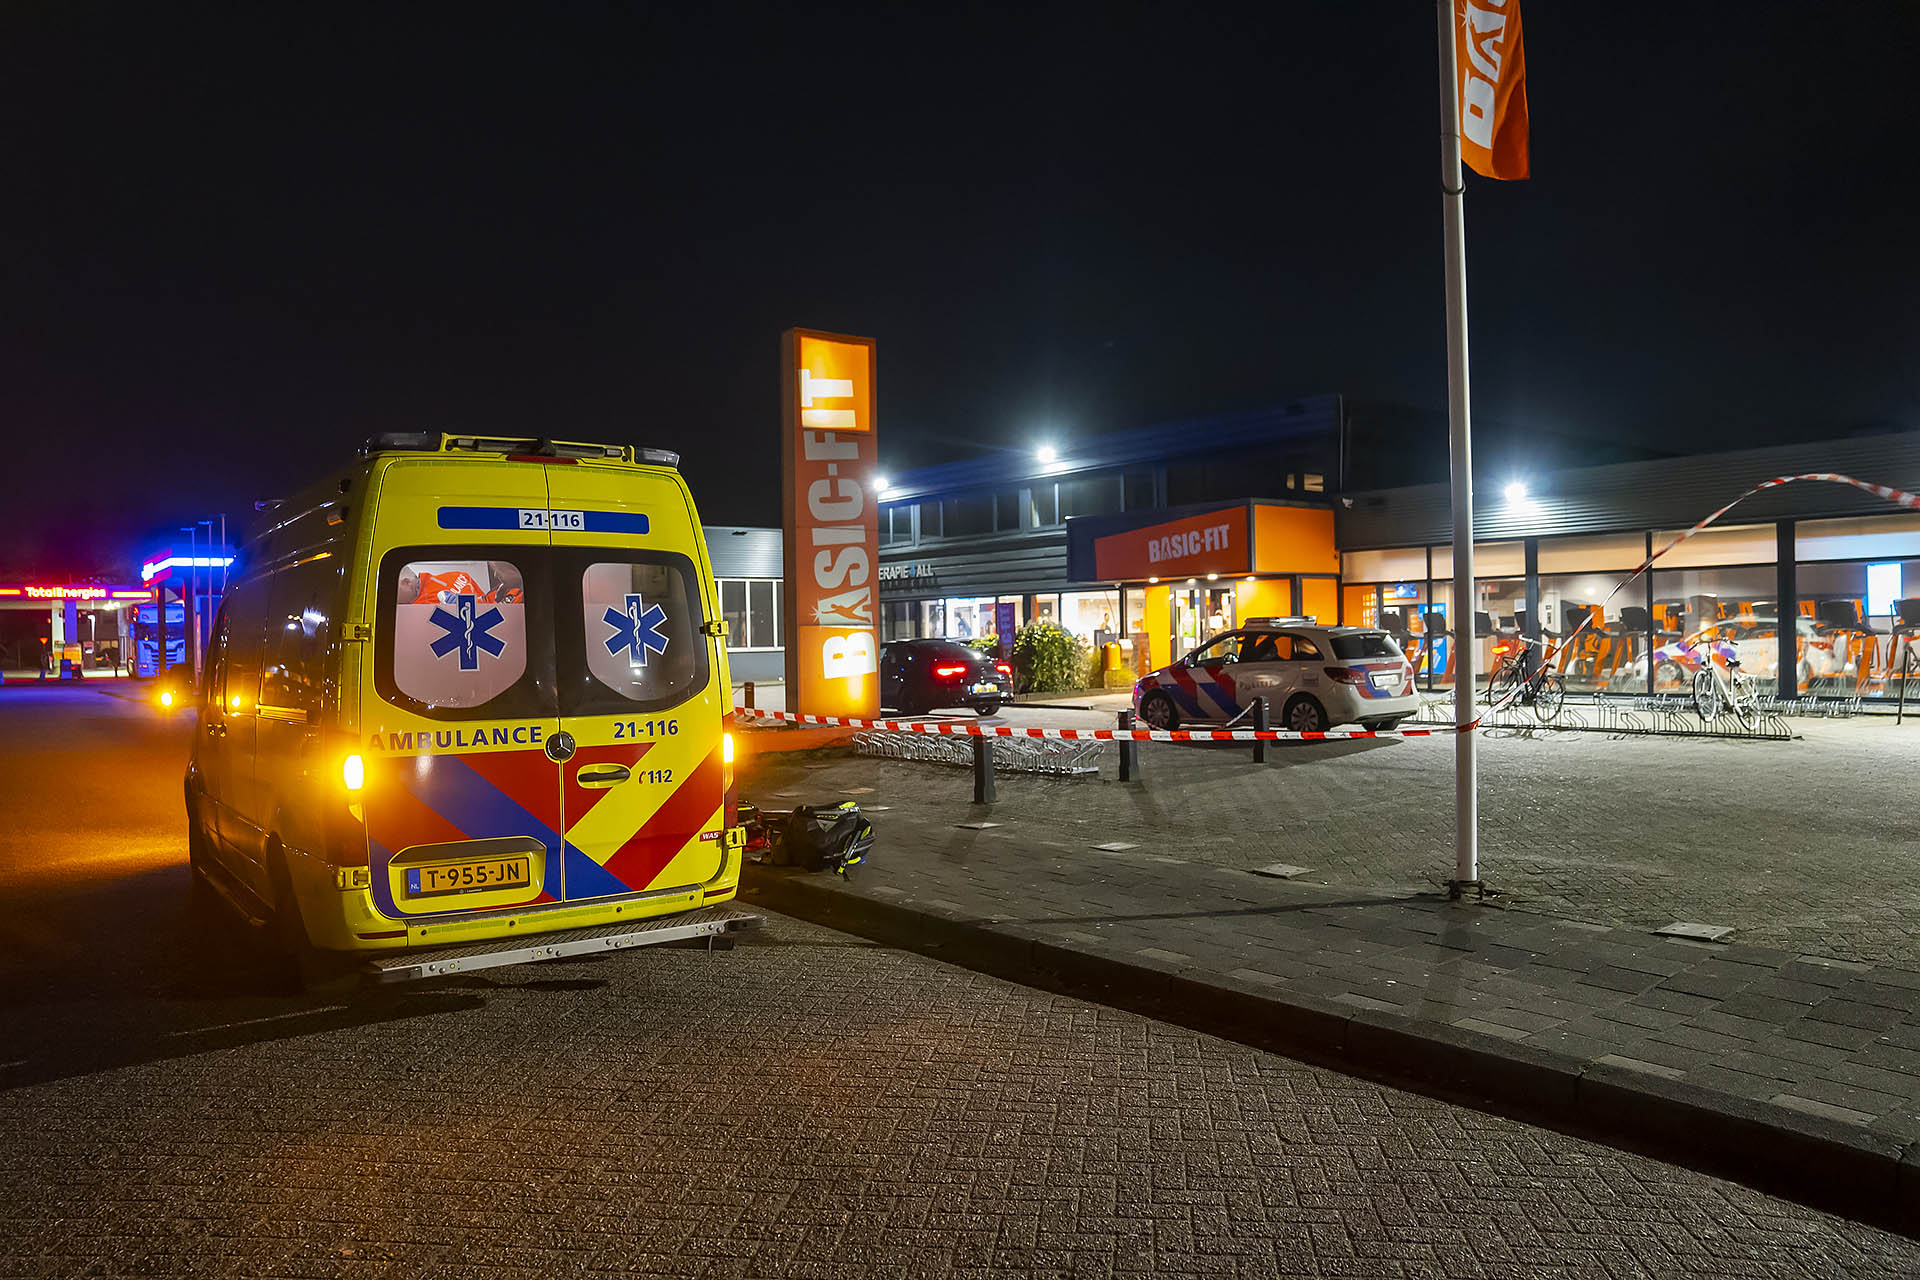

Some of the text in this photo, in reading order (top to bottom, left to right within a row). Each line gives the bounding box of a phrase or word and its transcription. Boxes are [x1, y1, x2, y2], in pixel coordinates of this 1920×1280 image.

[1463, 0, 1507, 149] BA
[523, 512, 580, 527] 21-116
[799, 369, 877, 679] BASIC-FIT
[1148, 524, 1230, 563] BASIC-FIT
[25, 587, 107, 600] TotalEnergies
[369, 726, 543, 751] AMBULANCE
[614, 719, 679, 738] 21-116
[702, 832, 719, 840] WAS
[427, 862, 520, 888] T-955-JN
